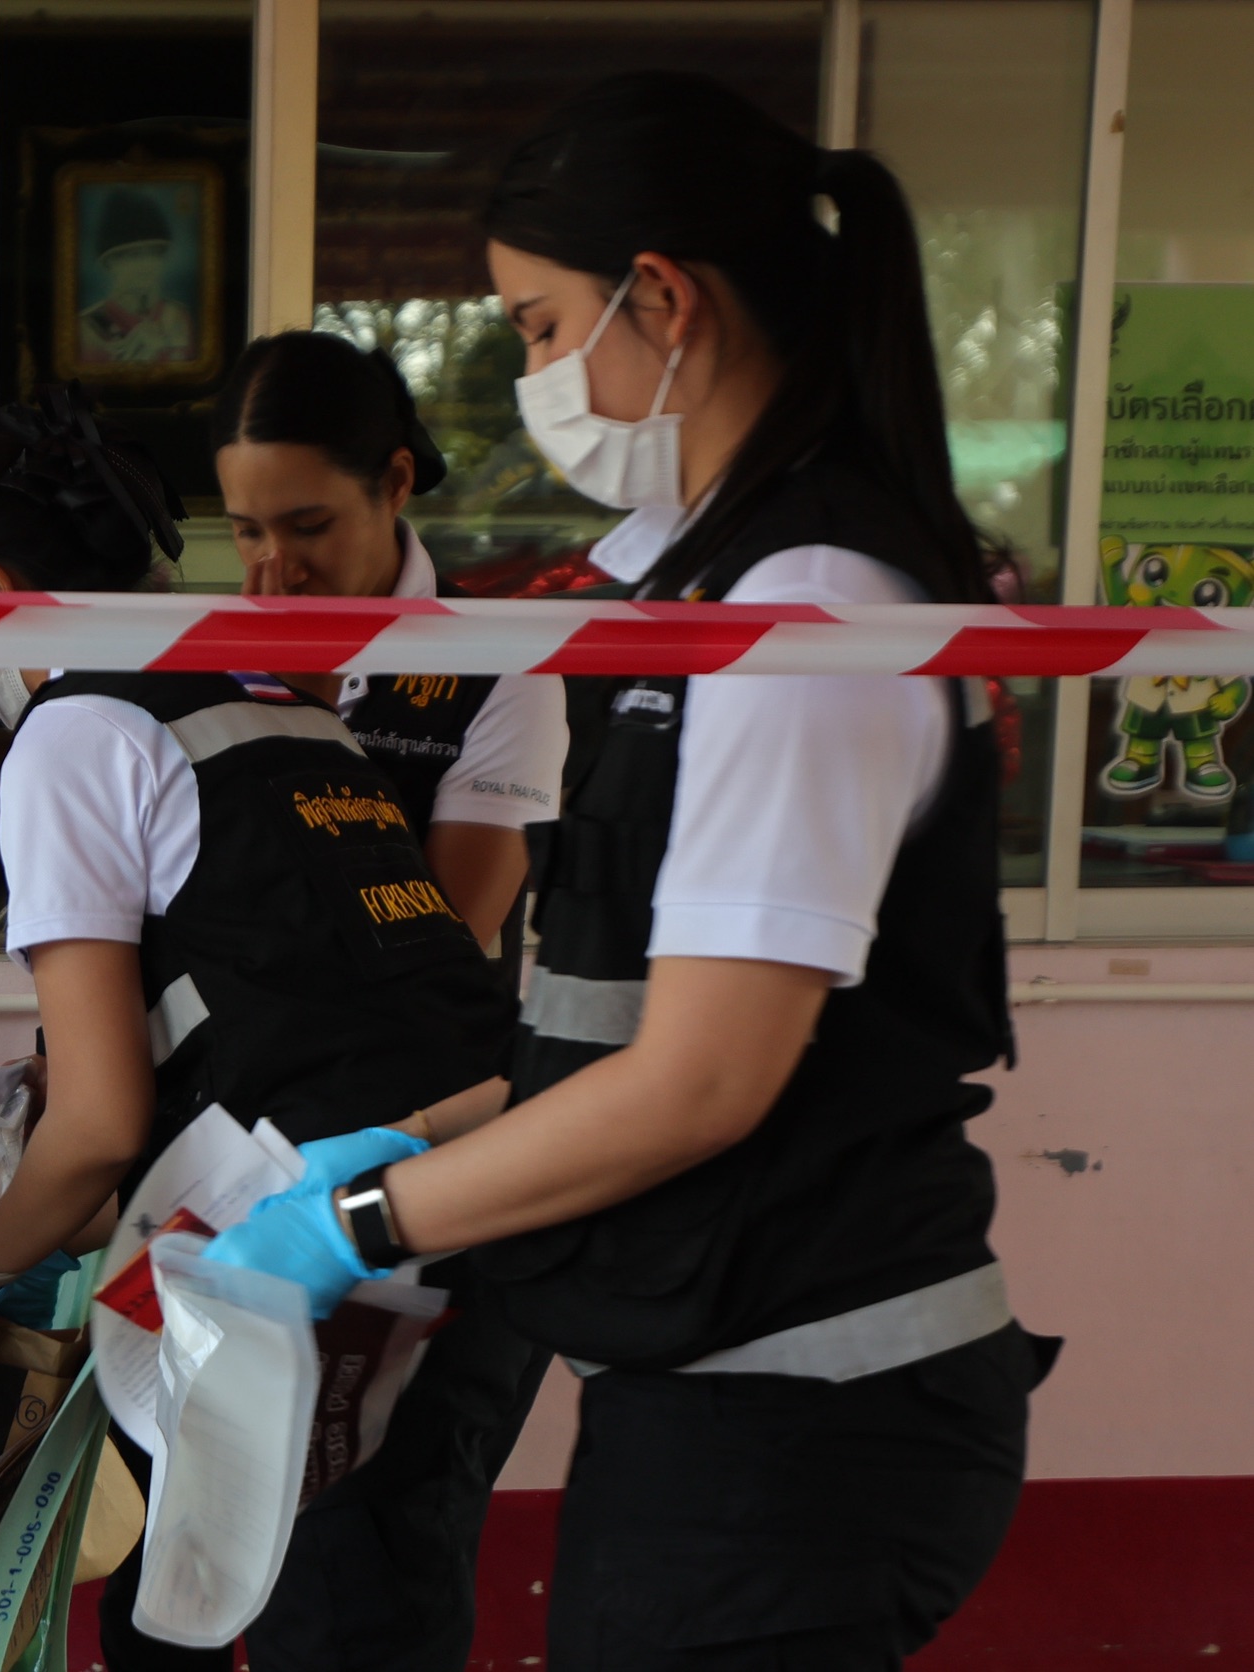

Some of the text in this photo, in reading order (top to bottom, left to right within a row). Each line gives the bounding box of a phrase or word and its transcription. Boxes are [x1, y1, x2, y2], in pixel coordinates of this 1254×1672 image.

[1107, 379, 1254, 421] บัตรเลือก
[471, 780, 505, 794] ROYAL
